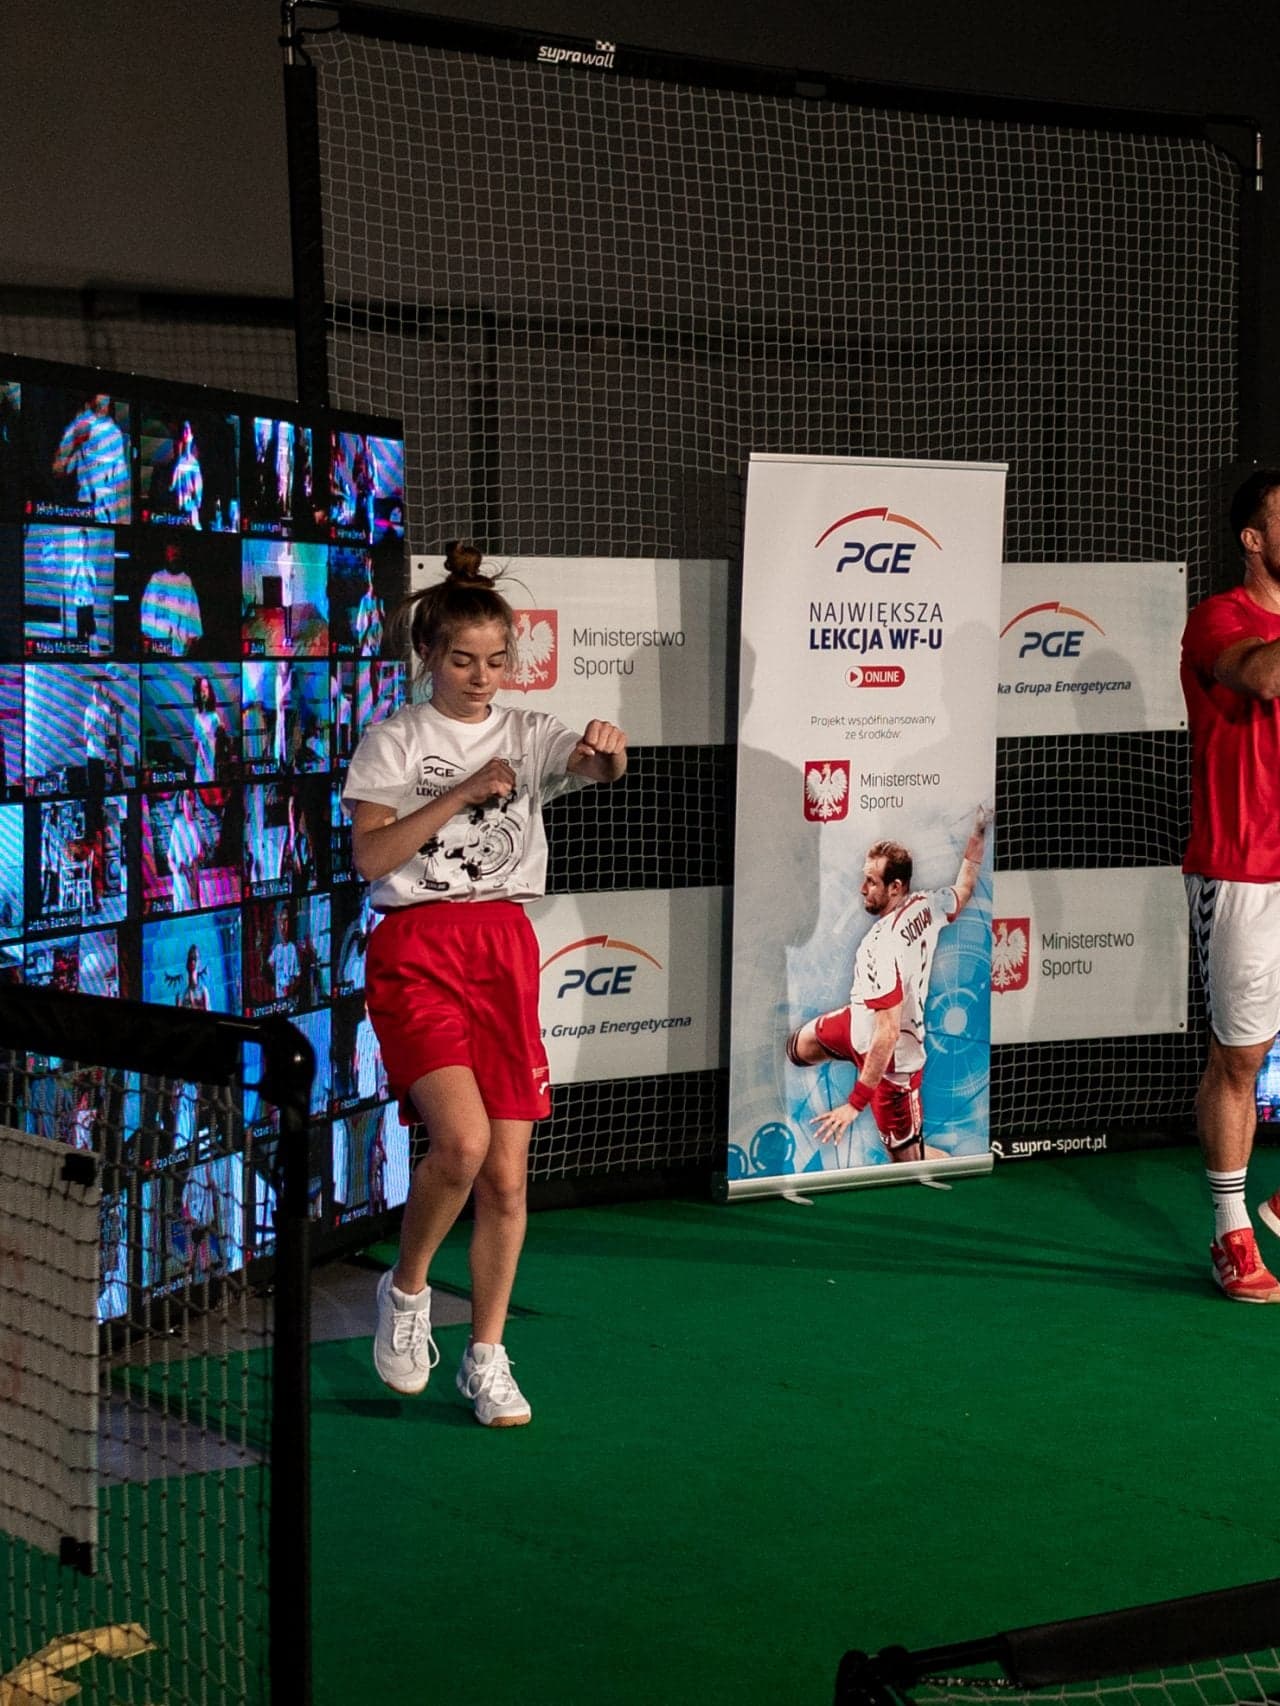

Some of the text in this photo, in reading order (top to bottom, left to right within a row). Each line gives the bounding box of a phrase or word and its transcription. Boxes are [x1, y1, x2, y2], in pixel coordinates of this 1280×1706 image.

[538, 45, 615, 68] suprawall
[836, 541, 917, 573] PGE
[809, 602, 943, 627] NAJWIĘKSZA
[573, 627, 686, 647] Ministerstwo
[809, 628, 943, 654] LEKCJA WF-U
[1018, 631, 1085, 658] PGE
[573, 656, 635, 680] Sportu
[864, 671, 900, 683] ONLINE
[1015, 682, 1052, 696] Grupa
[1055, 680, 1131, 695] Energetyczna
[811, 712, 936, 728] Projekt współfinansowany
[845, 727, 901, 740] ze środków
[860, 773, 941, 788] Ministerstwo
[860, 794, 904, 812] Sportu
[1041, 932, 1135, 950] Ministerstwo
[1041, 959, 1093, 979] Sportu
[556, 965, 637, 999] PGE
[551, 1023, 596, 1039] Grupa
[600, 1016, 692, 1036] Energetyczna
[1011, 1133, 1107, 1155] supra-sport.pl
